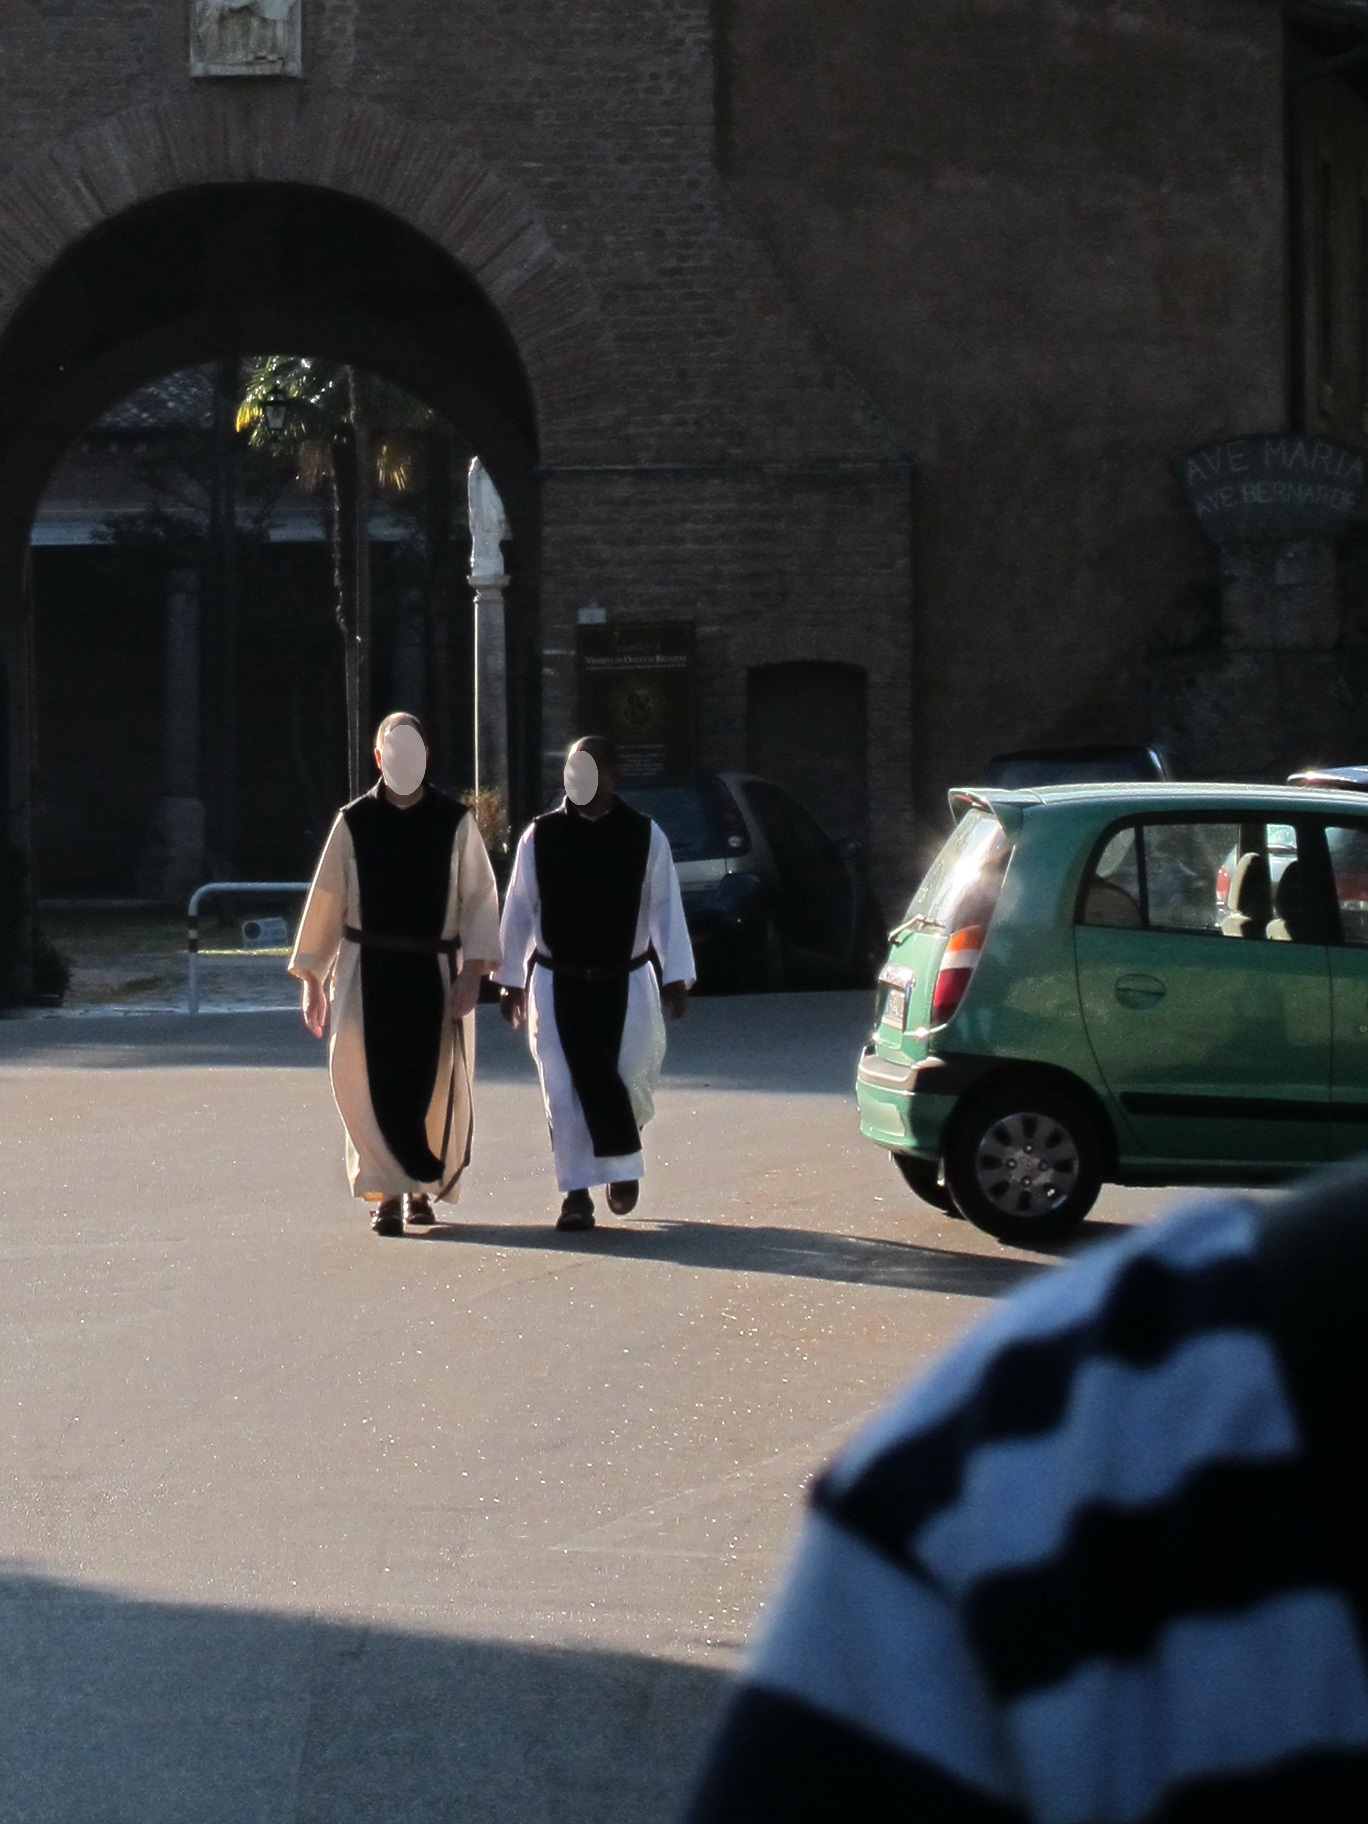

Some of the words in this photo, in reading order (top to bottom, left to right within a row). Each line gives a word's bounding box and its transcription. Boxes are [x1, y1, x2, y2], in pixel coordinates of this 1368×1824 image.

[1186, 440, 1249, 487] AVE
[1264, 438, 1364, 485] MARIA
[1194, 486, 1239, 519] AVE
[1240, 480, 1358, 510] BERNARDE
